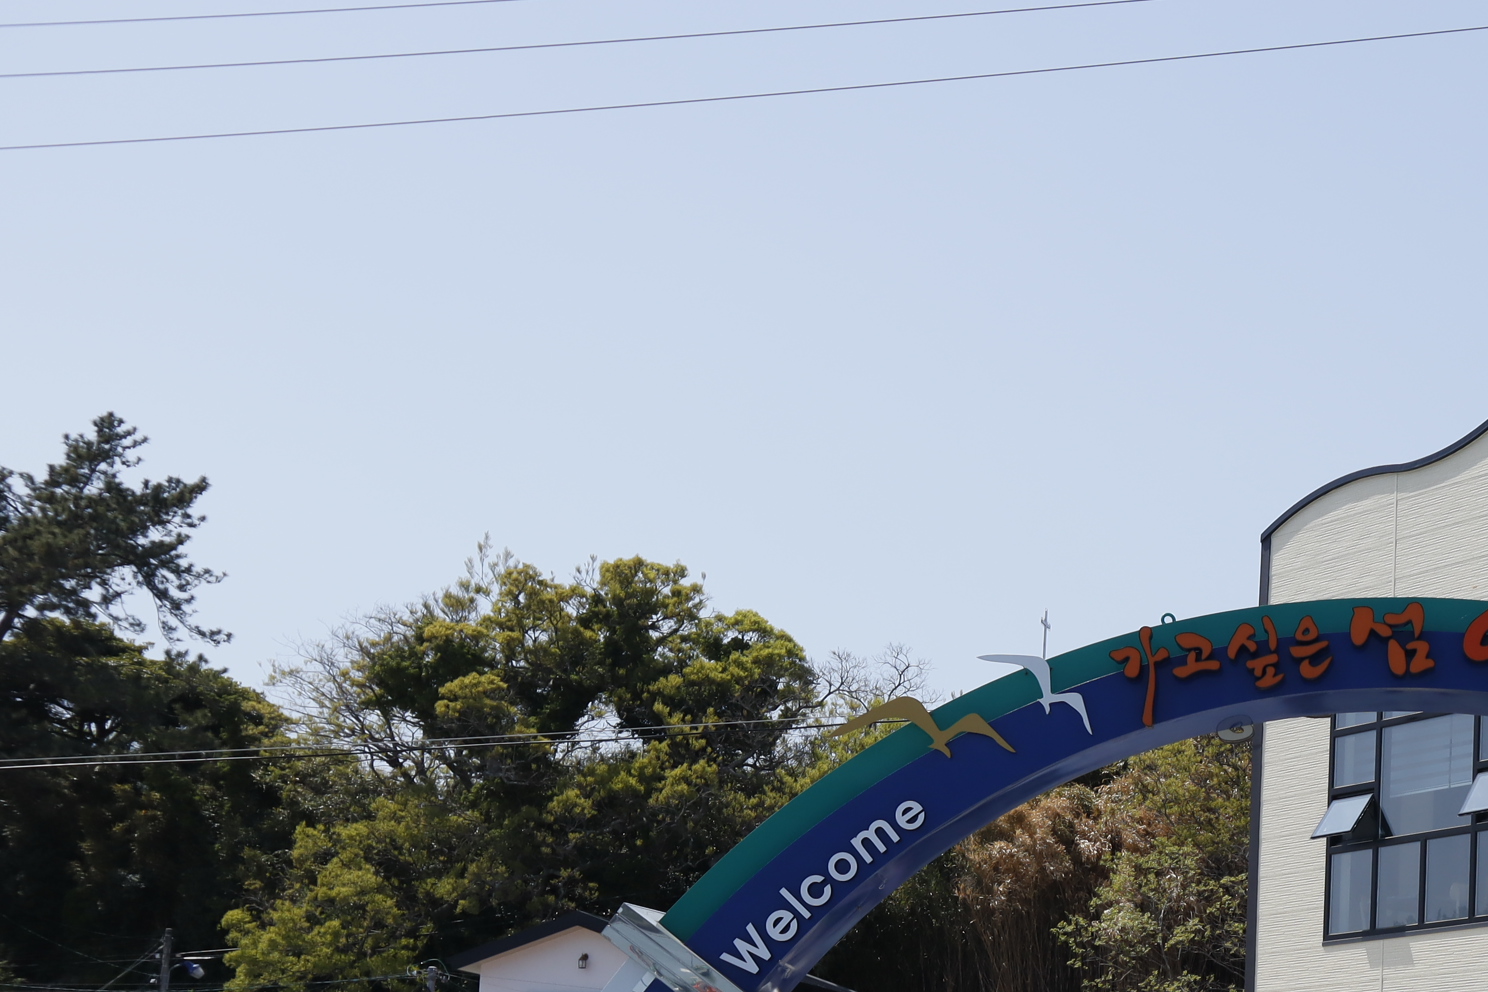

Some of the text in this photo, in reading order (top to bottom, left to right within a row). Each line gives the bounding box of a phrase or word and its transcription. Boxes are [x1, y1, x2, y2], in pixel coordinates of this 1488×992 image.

[1109, 614, 1332, 728] 가고싶은
[1350, 602, 1435, 677] 섬
[719, 800, 926, 976] Welcome
